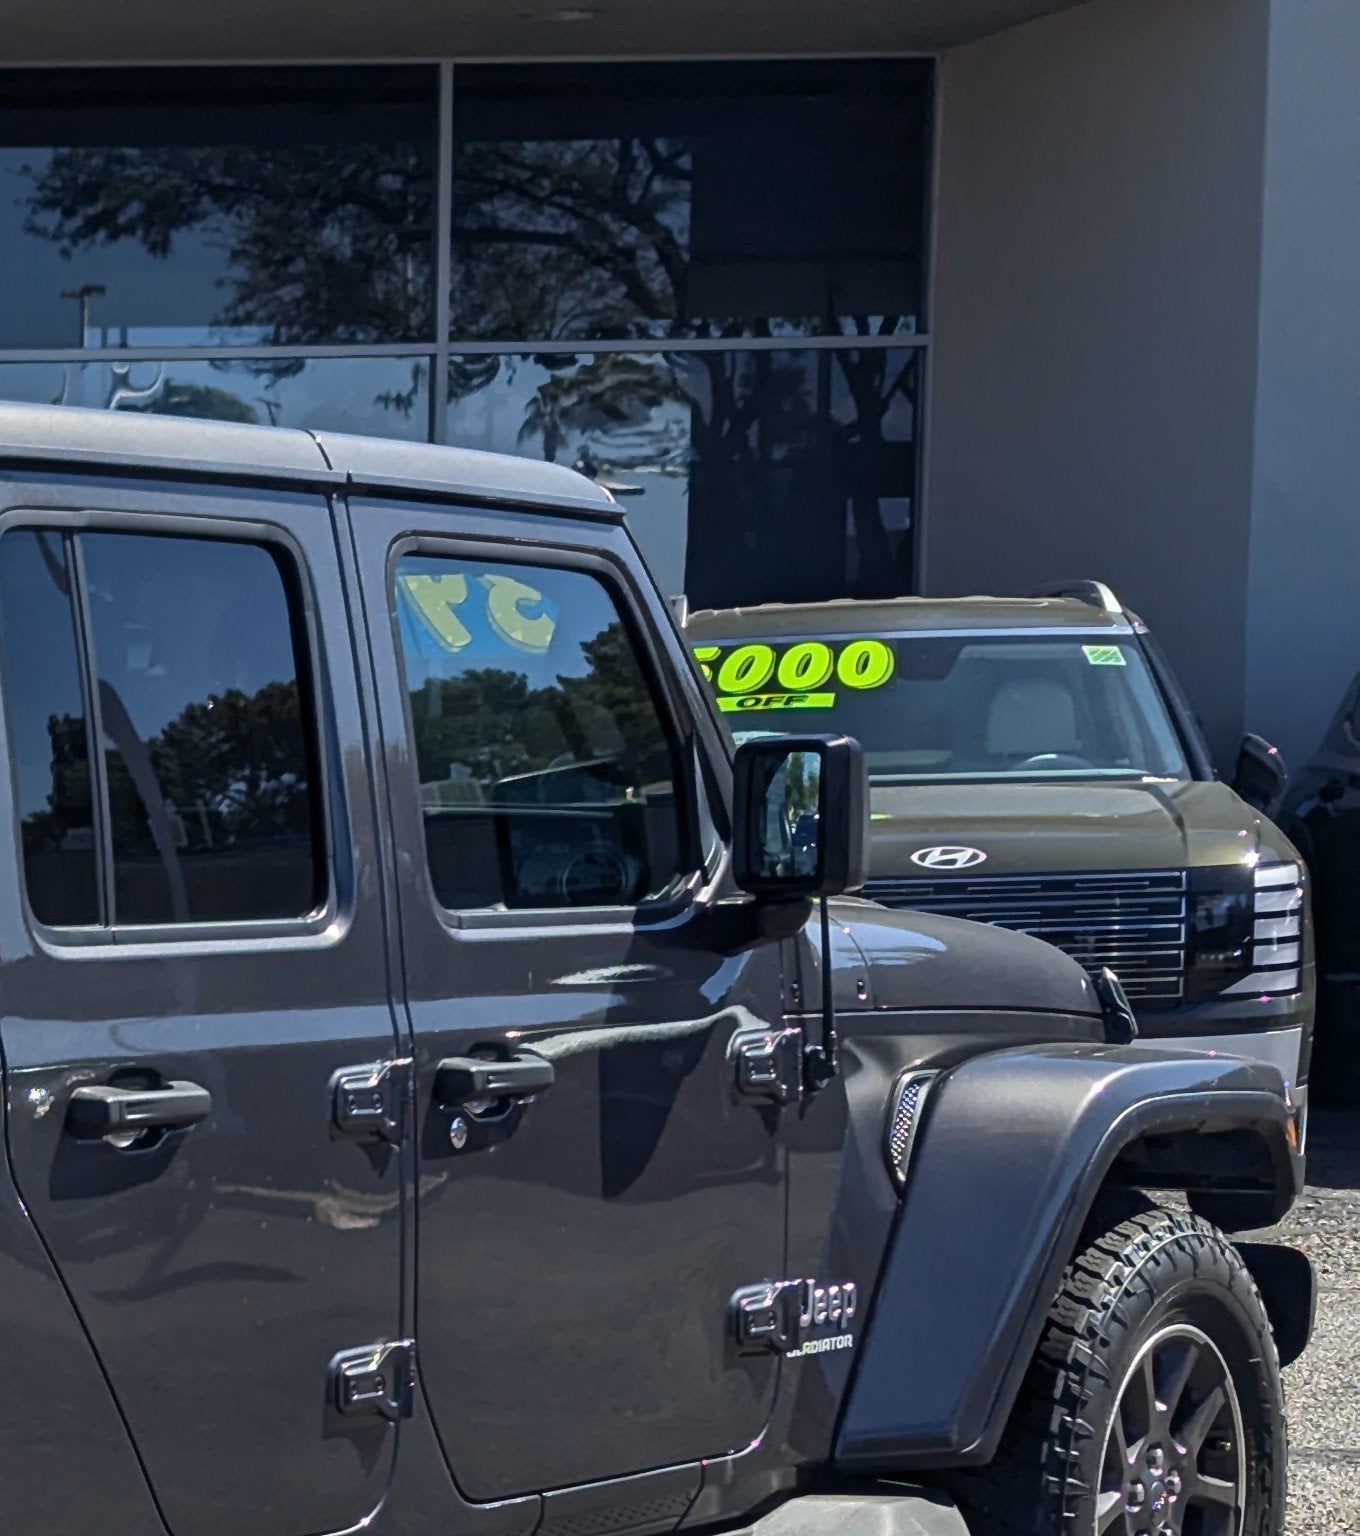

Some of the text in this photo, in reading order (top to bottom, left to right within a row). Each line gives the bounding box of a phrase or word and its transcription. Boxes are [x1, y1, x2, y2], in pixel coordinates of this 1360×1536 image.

[736, 695, 809, 708] OFF
[800, 1279, 857, 1329] Jeep
[786, 1334, 853, 1357] ADIATOR
